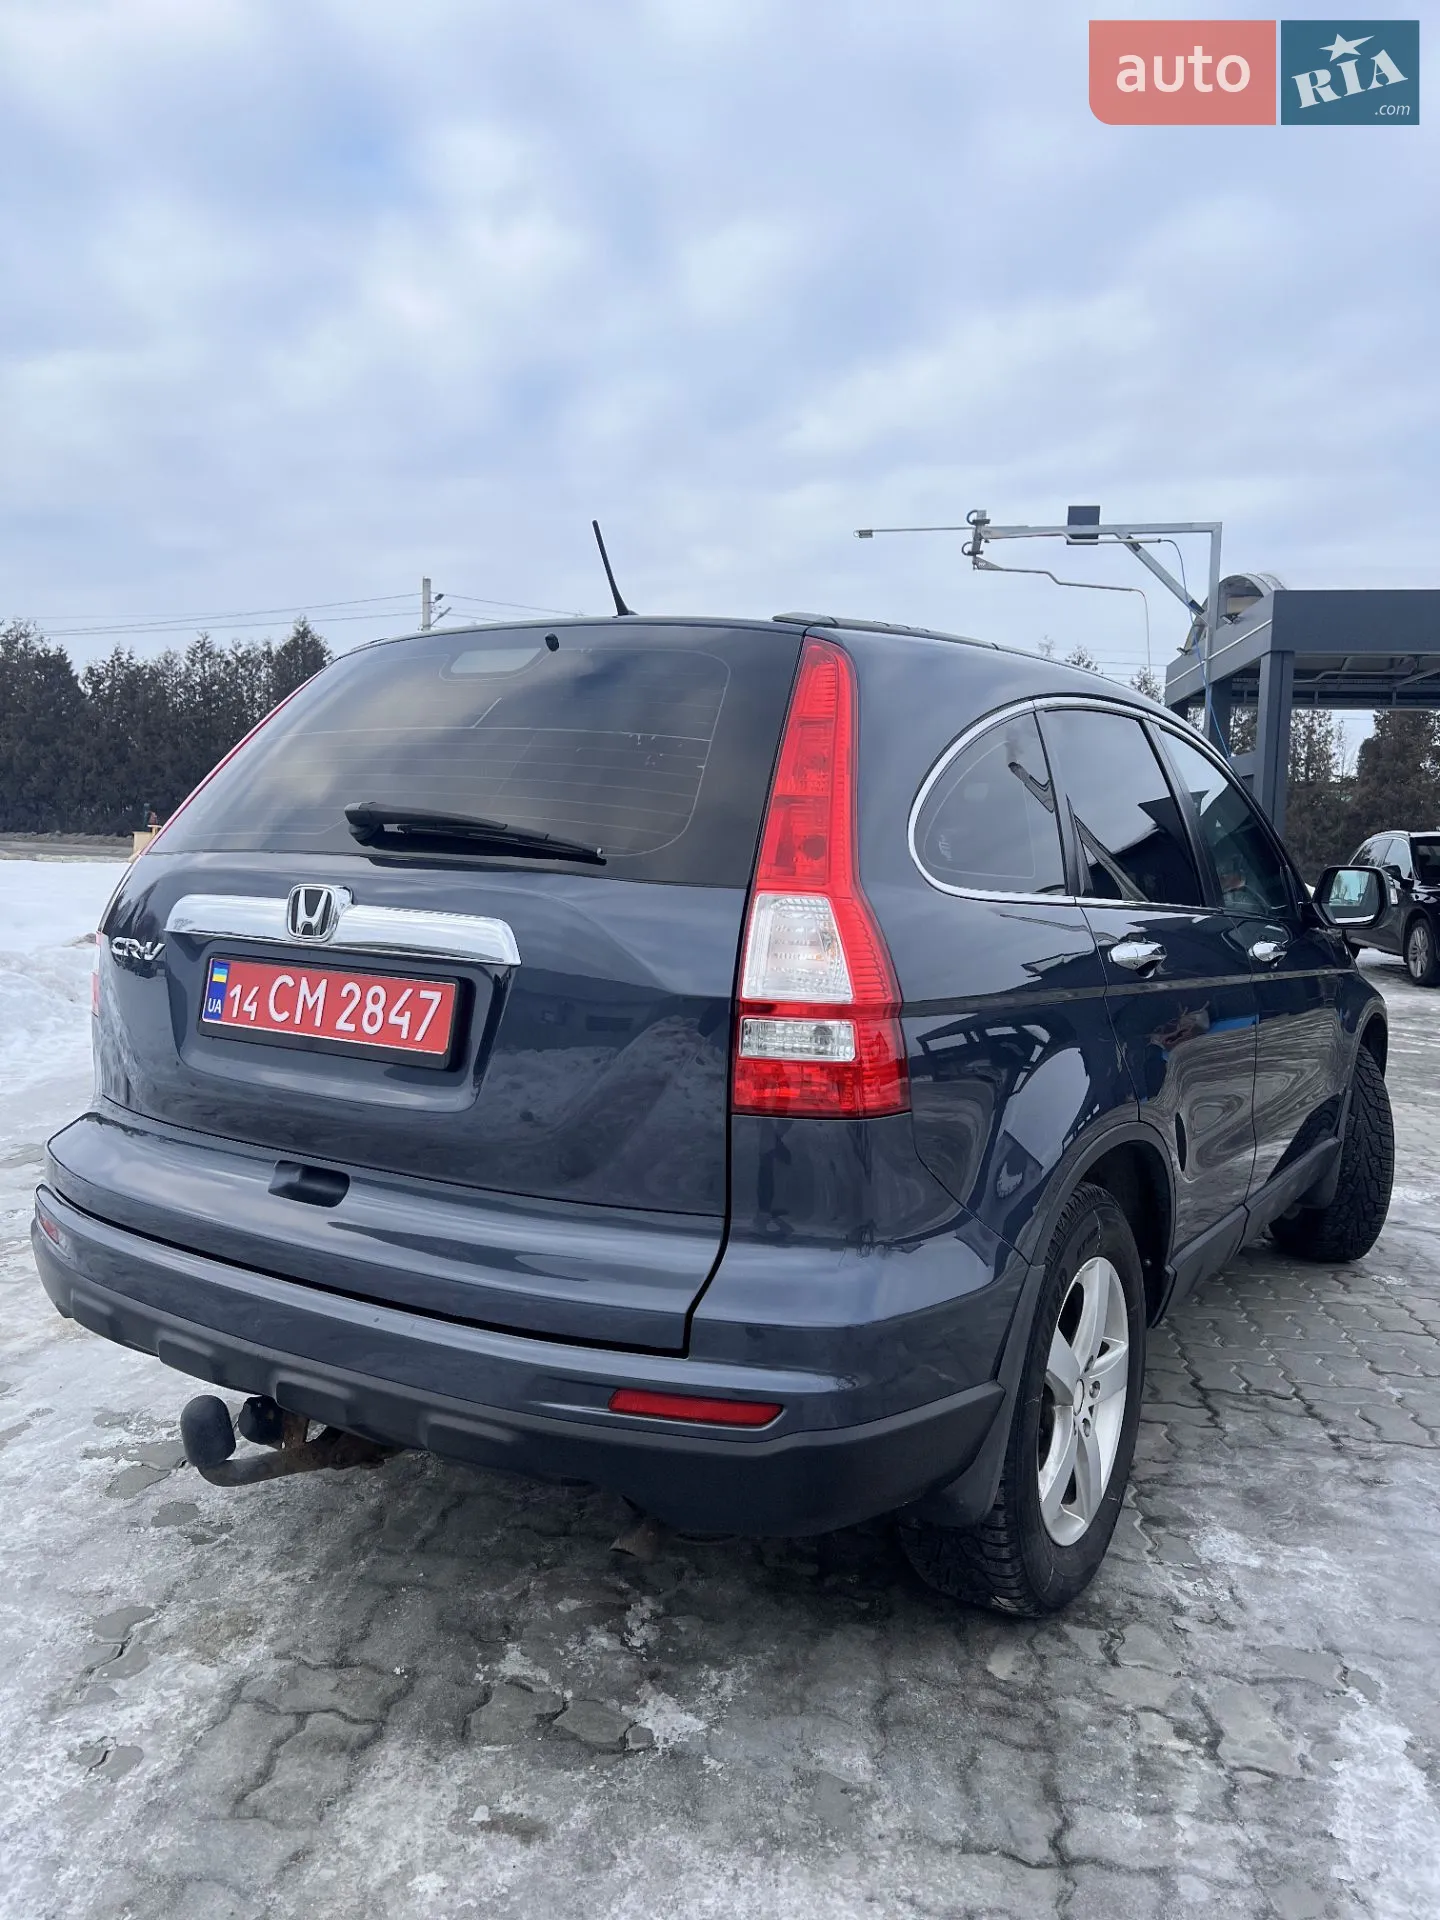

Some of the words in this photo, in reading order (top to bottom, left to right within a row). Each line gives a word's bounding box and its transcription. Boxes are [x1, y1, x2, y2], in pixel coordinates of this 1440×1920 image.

[111, 936, 166, 961] CR-V
[207, 998, 222, 1015] UA
[229, 984, 260, 1021] 14
[268, 974, 328, 1027] CM
[335, 982, 442, 1042] 2847
